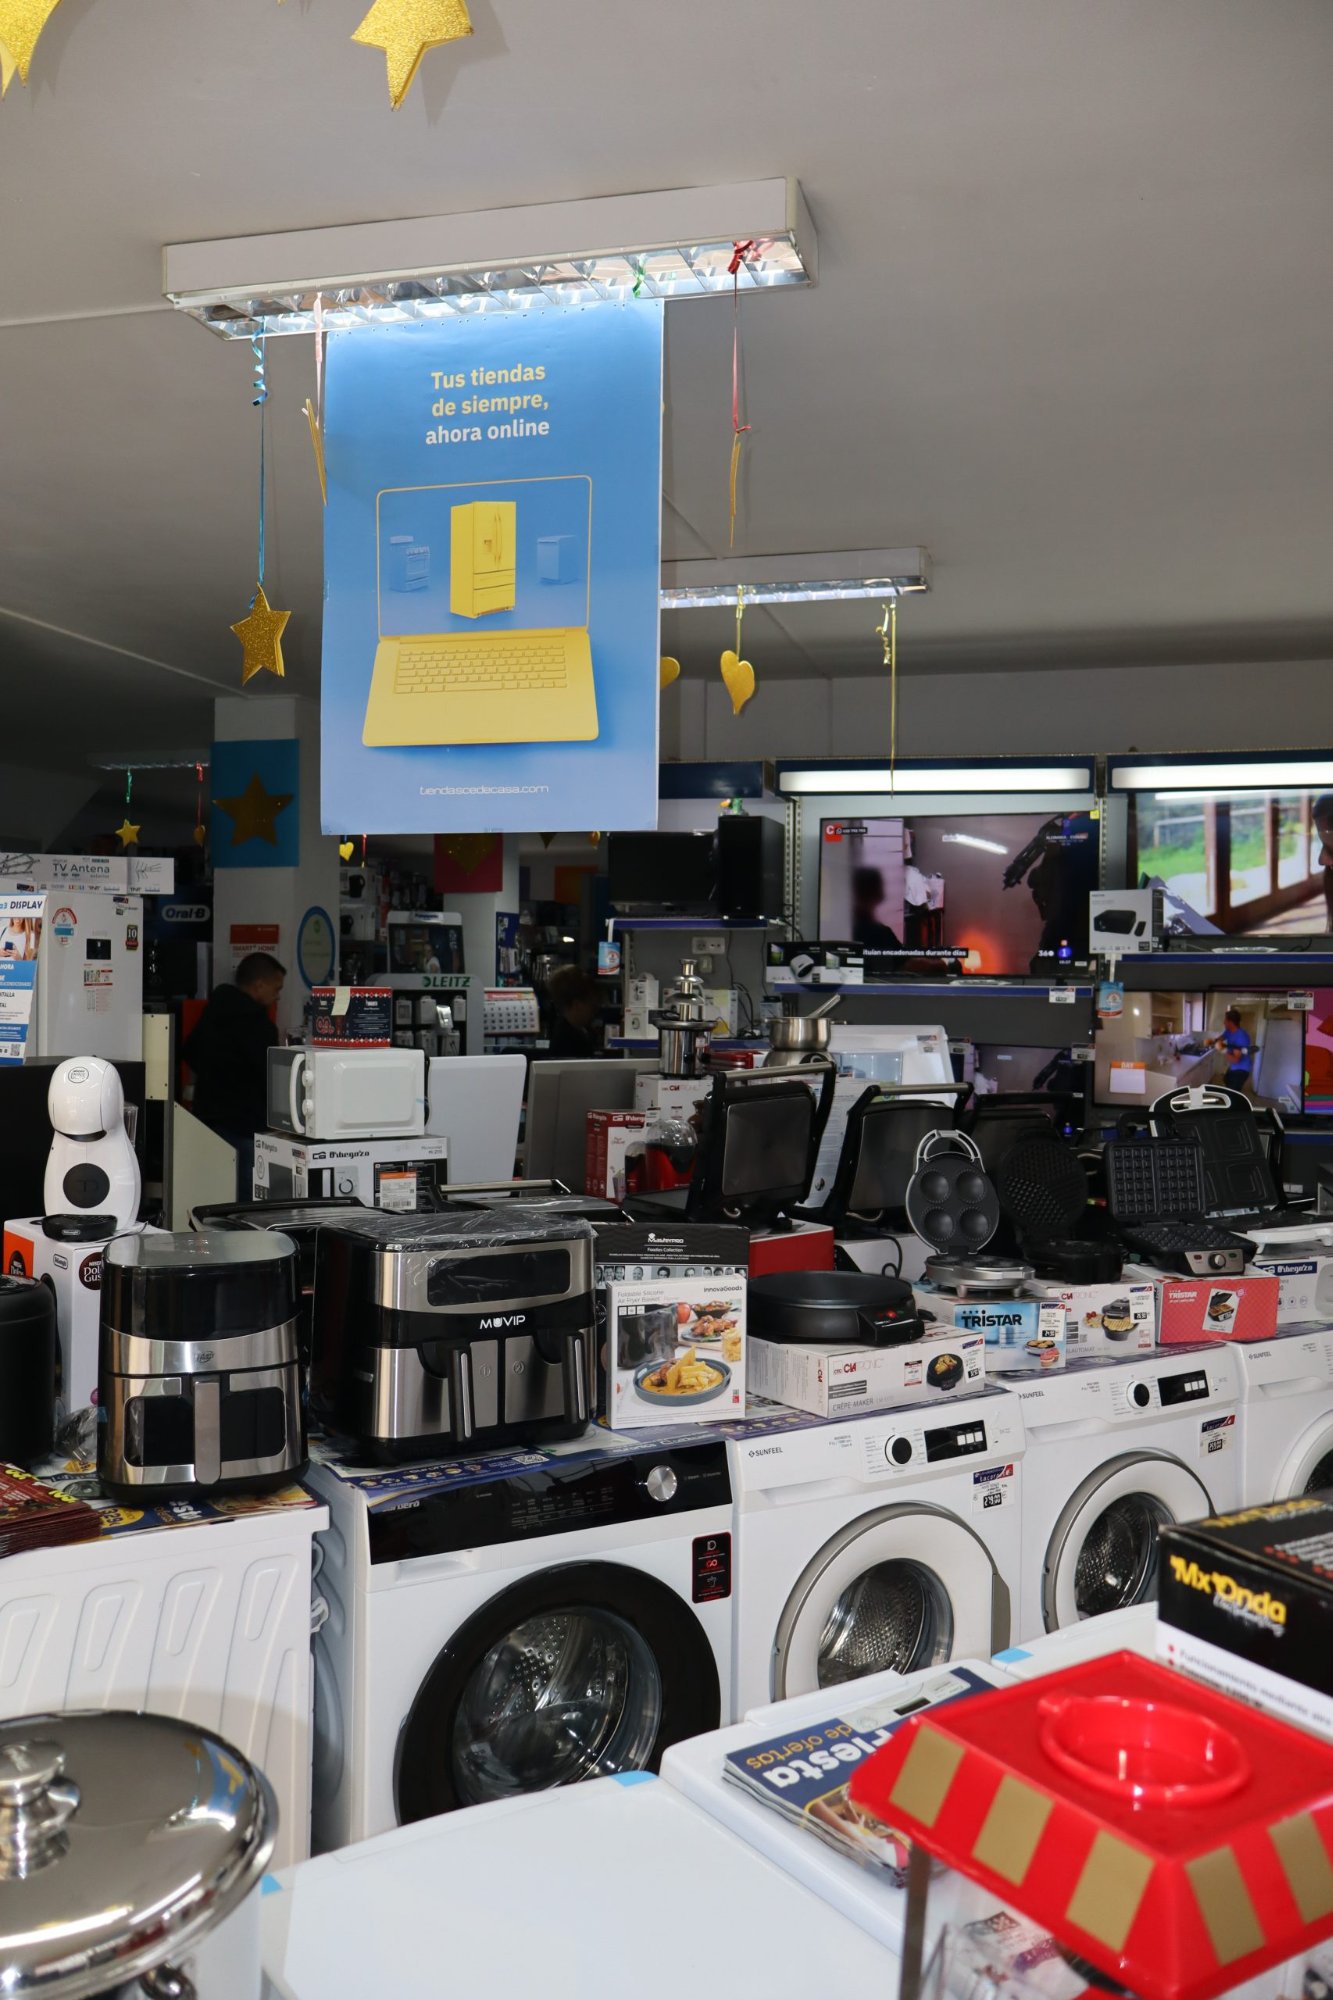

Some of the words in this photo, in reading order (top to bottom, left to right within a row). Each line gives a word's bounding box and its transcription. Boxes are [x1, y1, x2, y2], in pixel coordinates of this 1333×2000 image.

[431, 371, 466, 390] Tus
[471, 363, 546, 386] tiendas
[432, 398, 456, 417] de
[461, 393, 549, 414] siempre,
[425, 426, 482, 445] ahora
[487, 418, 550, 440] online
[53, 863, 67, 873] TV
[70, 864, 110, 873] Antena
[9, 901, 43, 909] DISPLAY
[166, 908, 205, 919] Oral-B
[926, 949, 952, 957] durante
[432, 976, 471, 988] LEITZ
[84, 1266, 101, 1277] Dol
[84, 1273, 102, 1283] Gus
[480, 1314, 526, 1330] MUVIP
[853, 1397, 874, 1408] MAKER
[755, 1446, 783, 1457] SUNFEEL
[824, 1724, 853, 1739] de
[746, 1734, 824, 1769] ofertas
